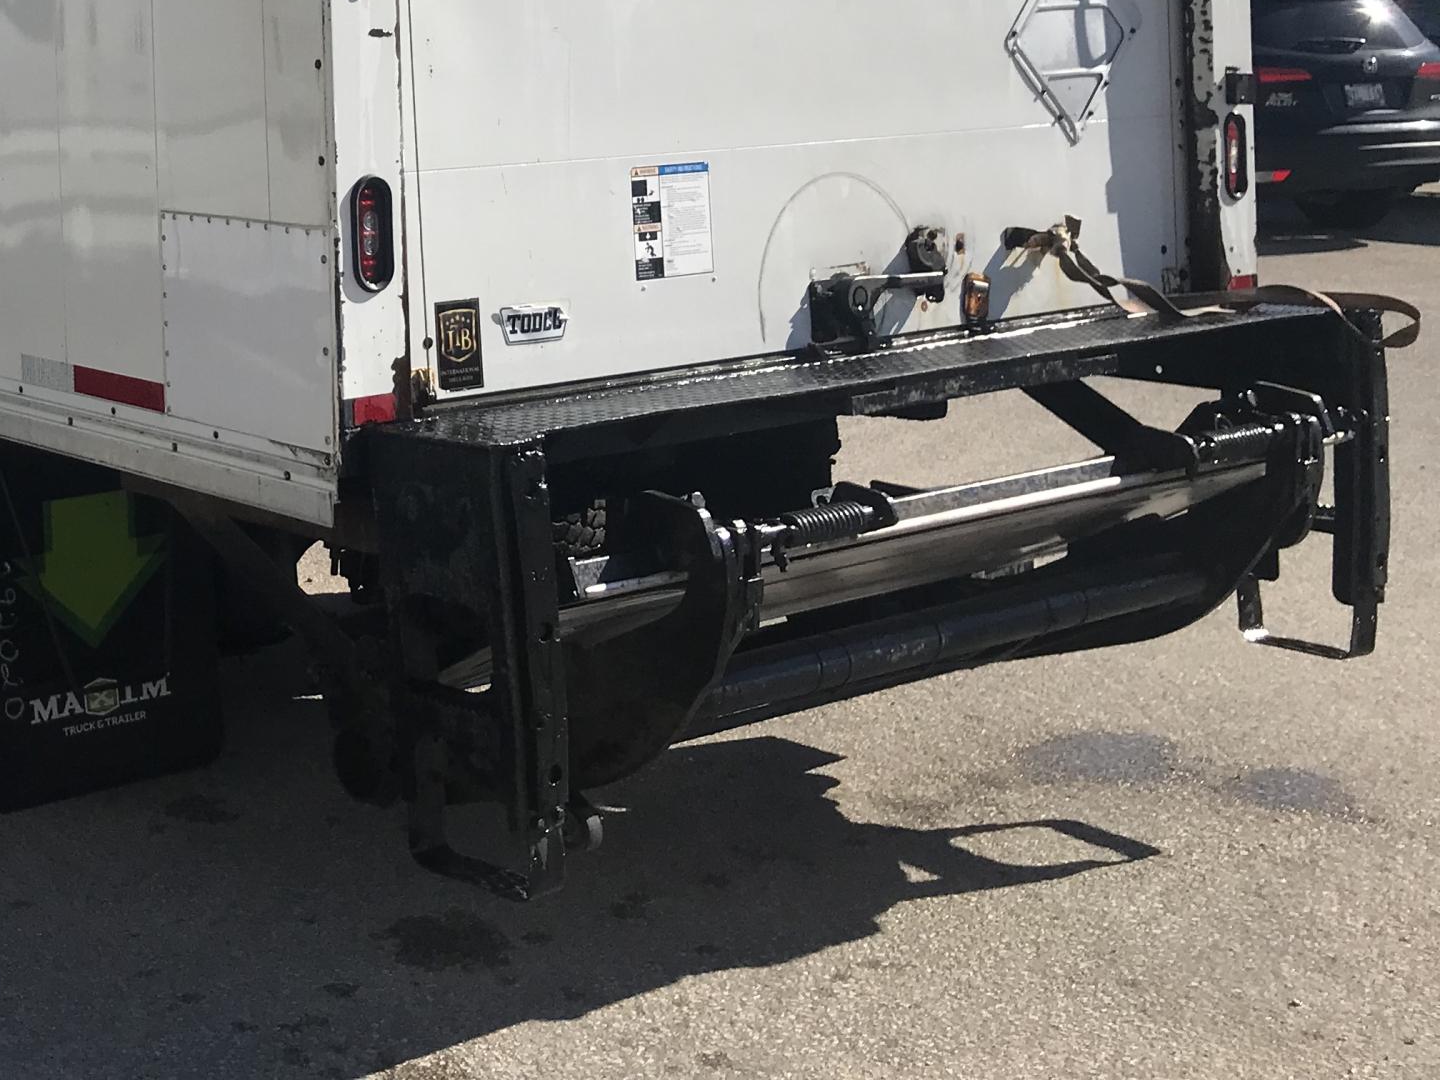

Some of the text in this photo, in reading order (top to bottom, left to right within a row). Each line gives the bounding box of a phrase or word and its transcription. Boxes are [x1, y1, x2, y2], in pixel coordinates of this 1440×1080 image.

[29, 676, 171, 725] MAXIM
[62, 710, 146, 737] TRUCK & TRAILER
